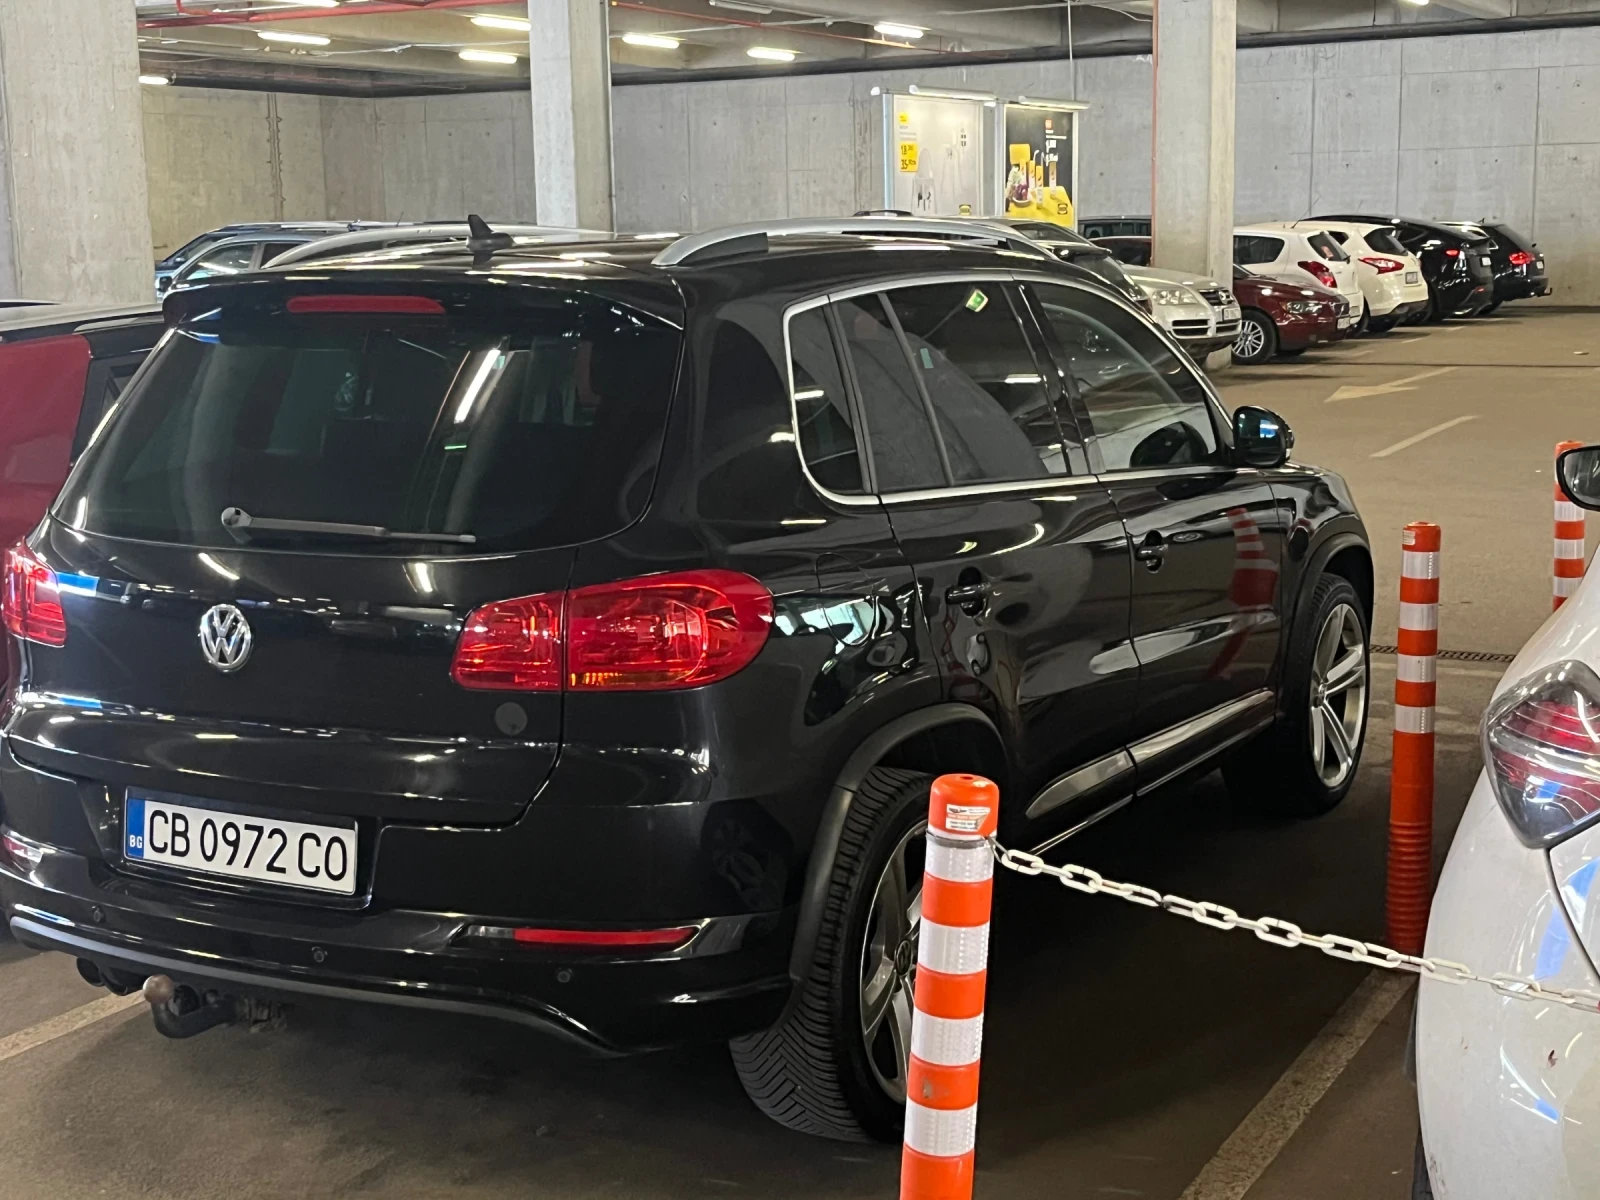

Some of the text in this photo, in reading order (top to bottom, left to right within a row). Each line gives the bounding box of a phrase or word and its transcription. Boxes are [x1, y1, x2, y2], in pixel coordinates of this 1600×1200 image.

[200, 604, 251, 669] VW
[129, 834, 143, 849] BG
[149, 809, 348, 882] CB 0972 CO
